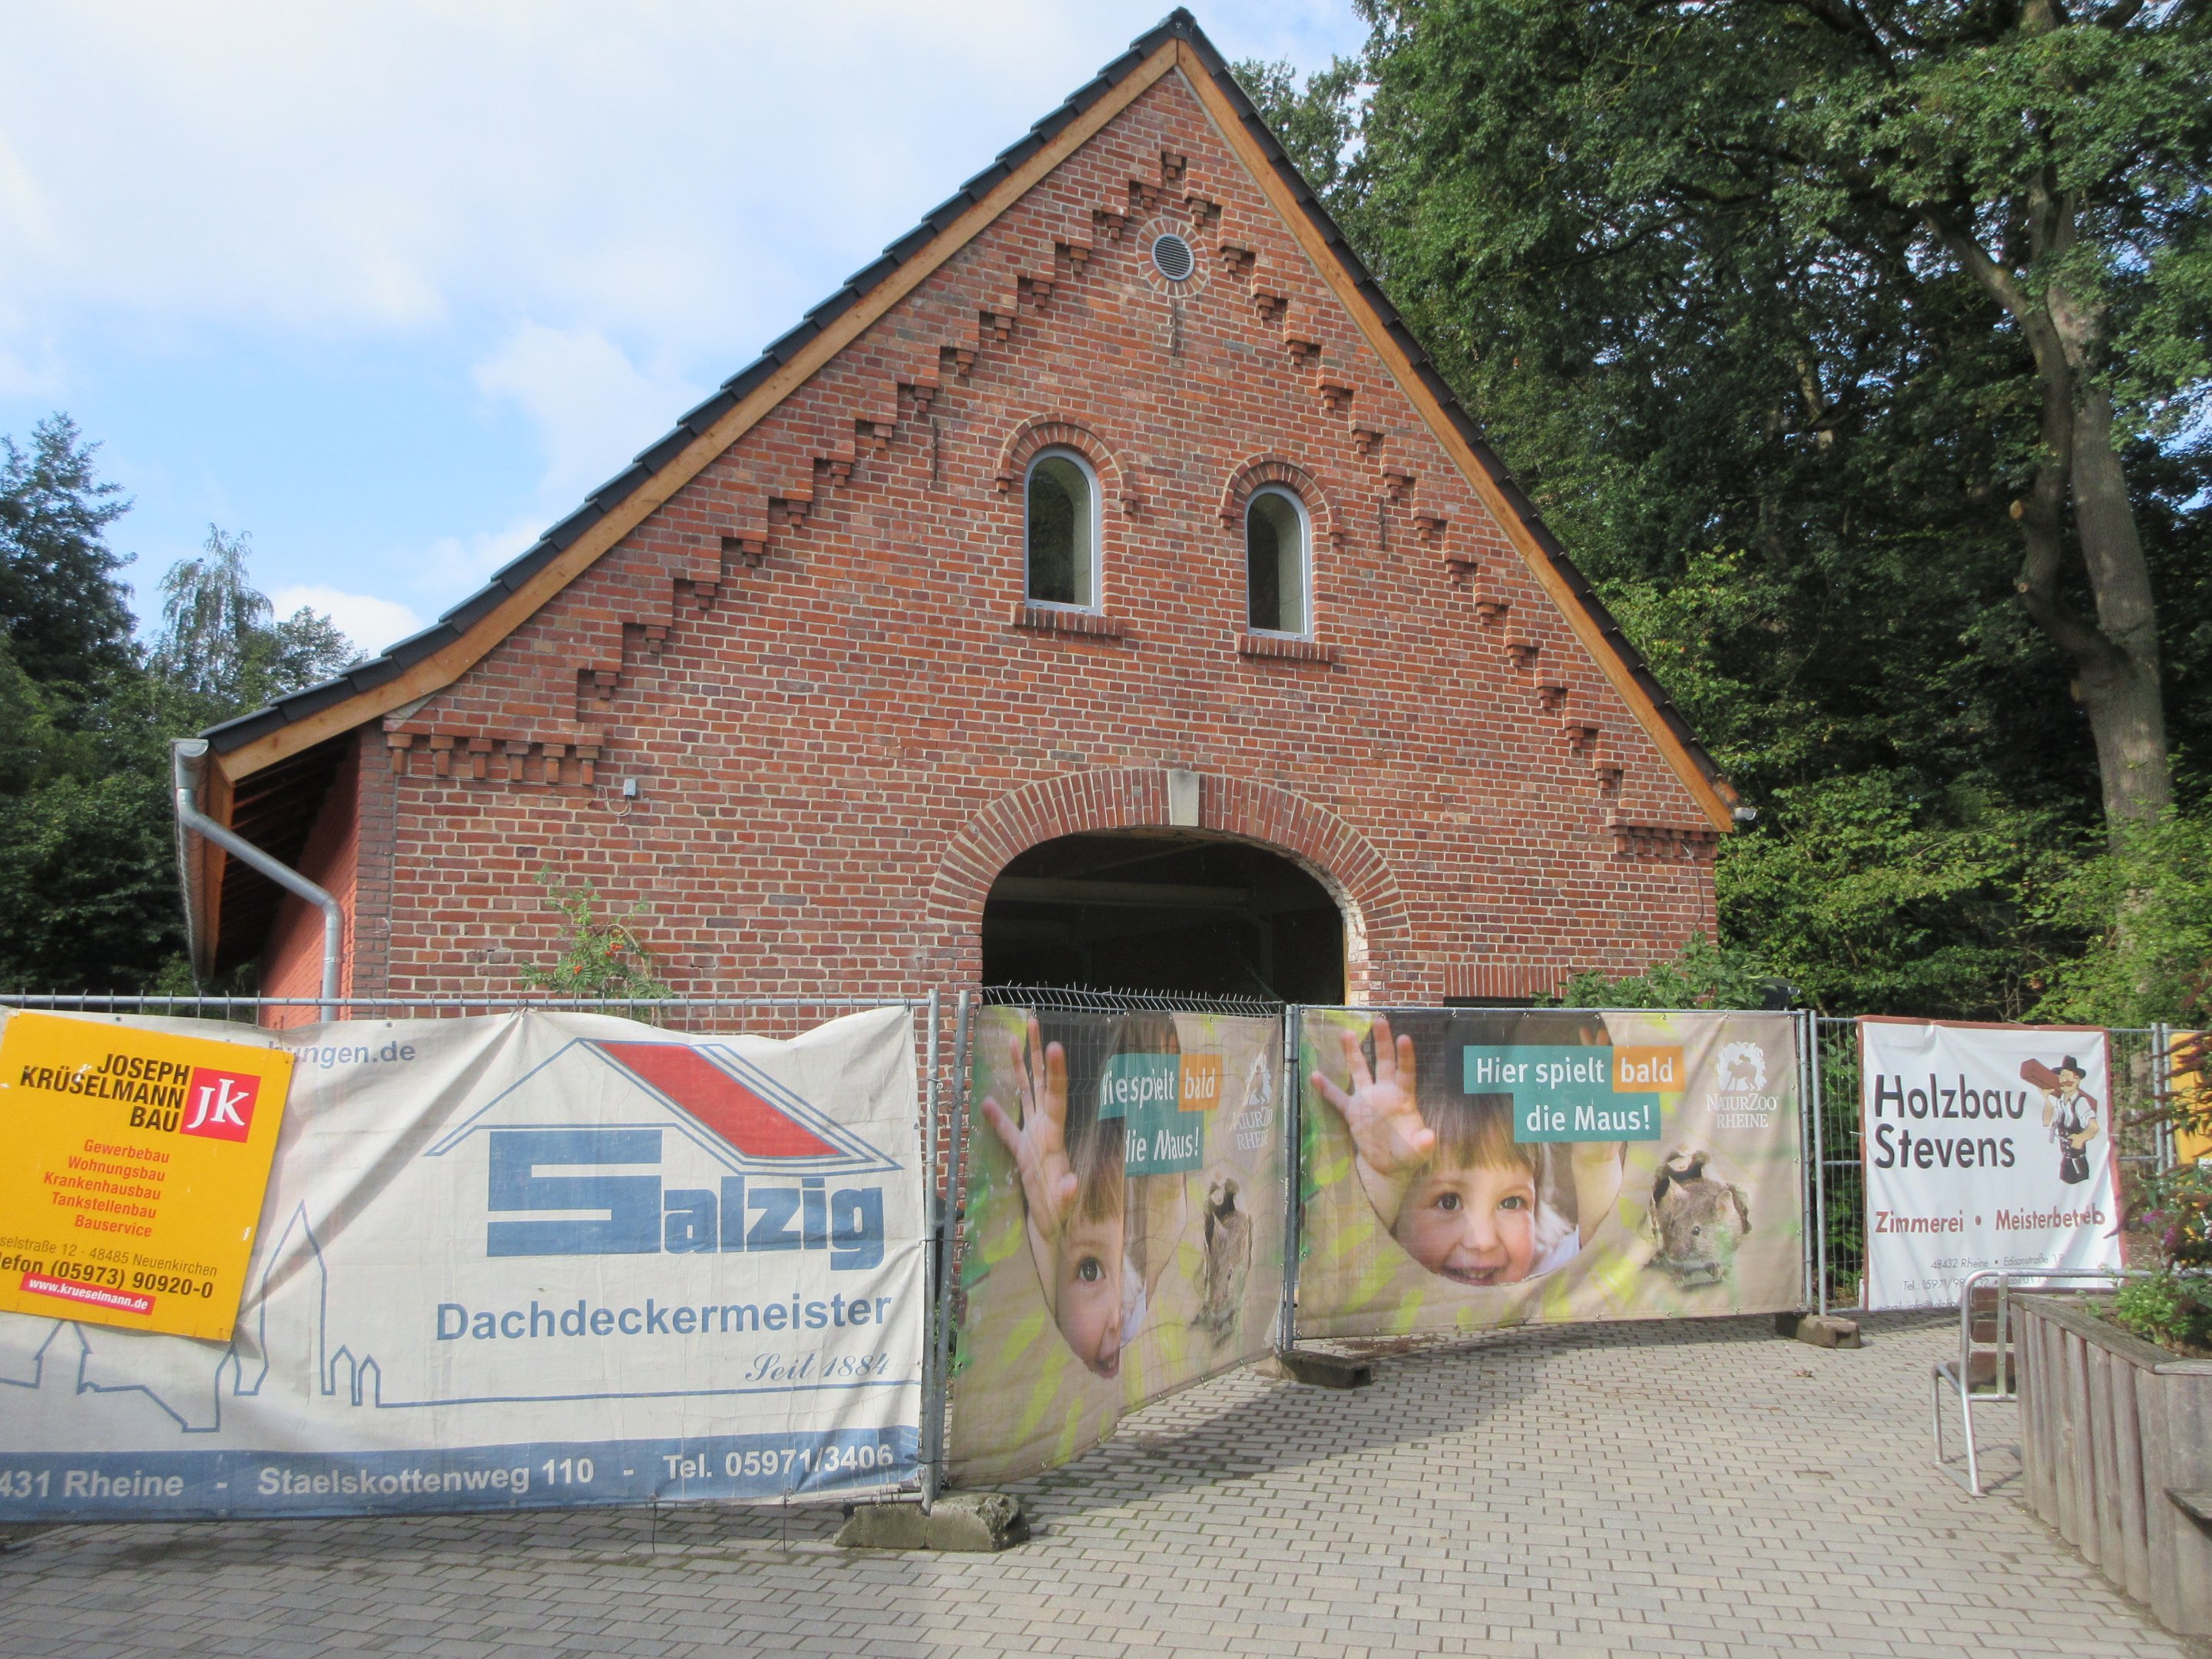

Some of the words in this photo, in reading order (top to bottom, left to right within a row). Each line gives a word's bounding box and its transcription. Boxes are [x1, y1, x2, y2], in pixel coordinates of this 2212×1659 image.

[97, 1053, 191, 1085] JOSEPH
[1476, 1057, 1528, 1084] Hier
[1535, 1056, 1604, 1089] spielt
[1621, 1057, 1674, 1083] bald
[20, 1065, 185, 1109] KRÜSELMANN
[1130, 1068, 1175, 1109] spielt
[1184, 1068, 1216, 1099] bald
[1873, 1073, 2027, 1120] Holzbau
[130, 1106, 180, 1133] BAU
[1526, 1104, 1565, 1131] die
[1575, 1104, 1650, 1131] Maus!
[1717, 1114, 1769, 1128] RHEINE
[84, 1139, 170, 1163] Gewerbebau
[1154, 1127, 1199, 1161] Maus!
[1874, 1123, 2015, 1169] Stevens
[68, 1156, 165, 1181] Wohnungsbau
[44, 1171, 161, 1200] Krankenhausbau
[486, 1129, 884, 1271] Salzig
[51, 1191, 157, 1219] Tankstellenbau
[75, 1214, 153, 1237] Bauservice
[1875, 1210, 1964, 1233] Zimmerei
[61, 1243, 78, 1257] 12
[89, 1247, 130, 1264] 48485
[133, 1253, 218, 1277] Neuenkirchen
[1961, 1257, 1988, 1268] Rheine
[28, 1277, 148, 1310] www.krueselmann.de
[51, 1259, 125, 1290] (05973)
[132, 1271, 214, 1299] 90920-0
[437, 1291, 892, 1342] Dachdeckermeister
[745, 1353, 817, 1382] Seit
[821, 1353, 890, 1377] 1884
[64, 1469, 184, 1498] Rheine
[258, 1465, 530, 1495] Staelskottenweg
[541, 1458, 594, 1485] 110
[663, 1454, 713, 1481] Tel.
[725, 1443, 894, 1477] 05971/3406
